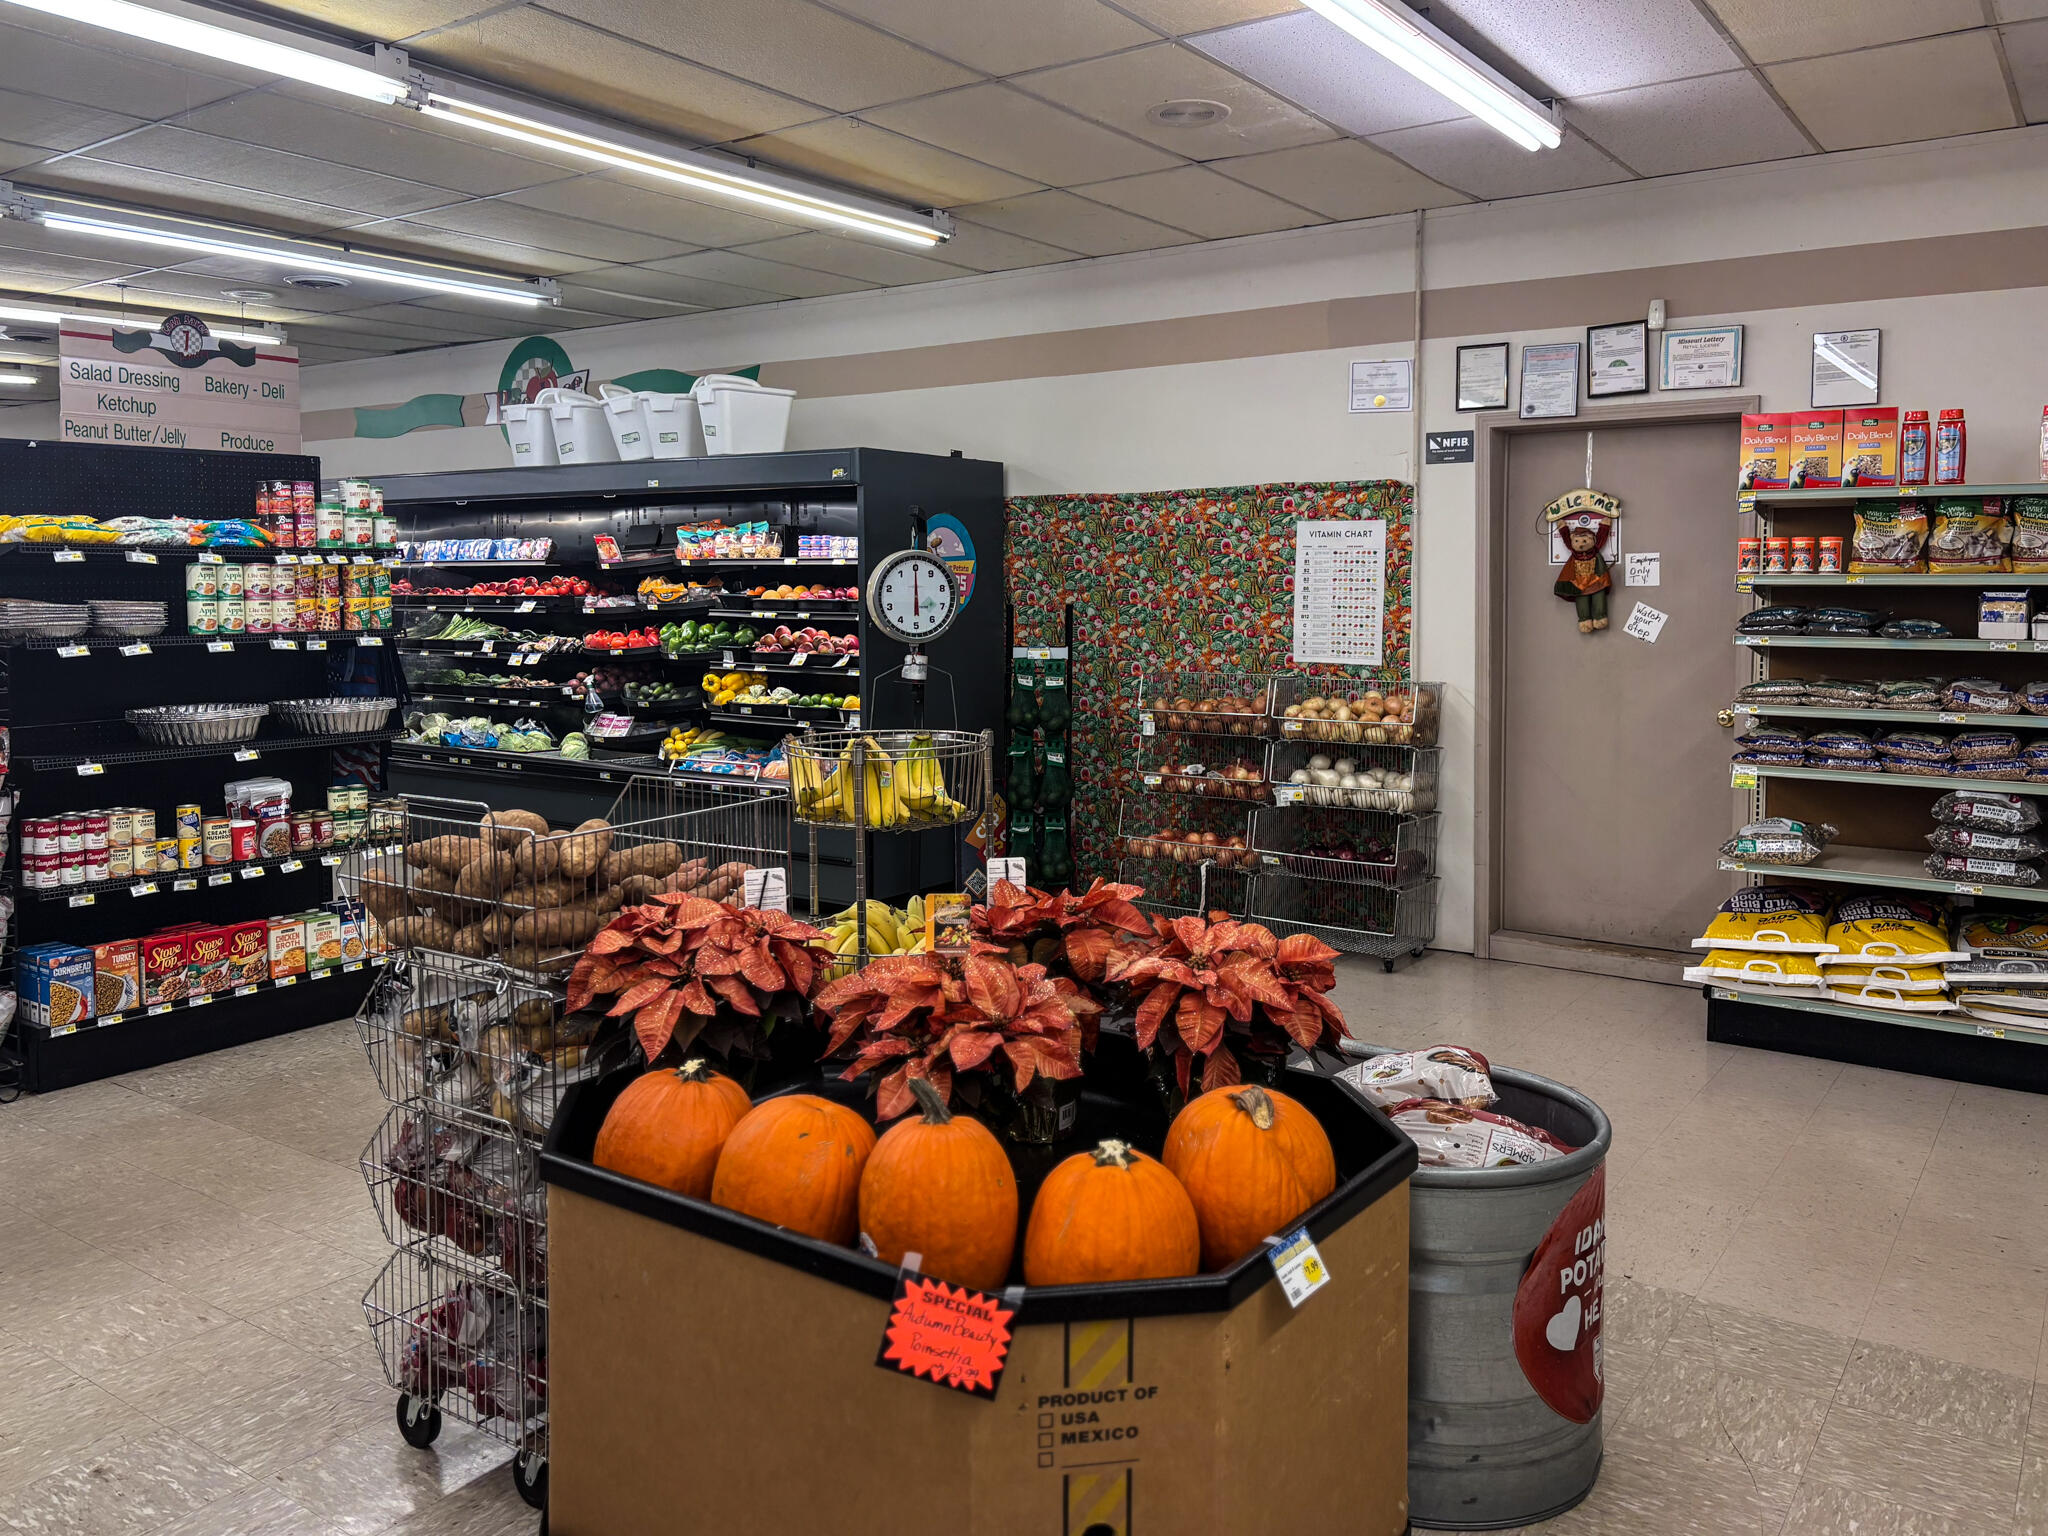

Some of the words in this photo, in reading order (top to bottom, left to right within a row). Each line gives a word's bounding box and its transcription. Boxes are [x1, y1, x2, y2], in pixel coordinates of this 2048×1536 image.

[70, 362, 112, 382] Salad
[118, 367, 180, 392] Dressing
[205, 376, 249, 399] Bakery
[262, 382, 285, 399] Deli
[98, 393, 156, 416] Ketchup
[65, 420, 108, 440] Peanut
[114, 424, 186, 448] Butter/Jelly
[1816, 433, 1838, 442] Blend
[1848, 432, 1869, 440] Daily
[1870, 431, 1893, 439] Blend
[221, 432, 274, 452] Produce
[1443, 437, 1468, 447] NFIB
[1863, 521, 1898, 529] Advanced
[2020, 518, 2048, 526] Advanc
[1630, 566, 1650, 577] Only
[1633, 615, 1653, 626] your
[1637, 604, 1661, 622] Watch
[1628, 624, 1650, 637] Step
[1765, 899, 1799, 909] WILD
[1874, 906, 1910, 915] WILD
[1758, 914, 1800, 922] Save
[1871, 922, 1915, 931] Save
[231, 929, 262, 953] Stove
[276, 932, 299, 942] CHICKEN
[276, 940, 300, 949] BROTH
[148, 944, 182, 968] Stove
[191, 938, 224, 961] Stove
[242, 942, 258, 955] Top
[112, 952, 136, 964] TURKEY
[161, 956, 178, 971] Top
[203, 950, 220, 963] Top
[53, 961, 91, 976] CORNBREAD
[1492, 1142, 1536, 1164] ARMER'S
[1304, 1260, 1319, 1275] $7.99
[1560, 1239, 1606, 1294] POTAT
[923, 1292, 992, 1322] SPECIAL
[902, 1302, 951, 1332] Autumn
[952, 1316, 998, 1352] Beauty
[1038, 1389, 1127, 1408] PRODUCT
[1134, 1387, 1158, 1402] OF
[1061, 1412, 1100, 1427] USA
[1061, 1426, 1138, 1445] MEXICO
